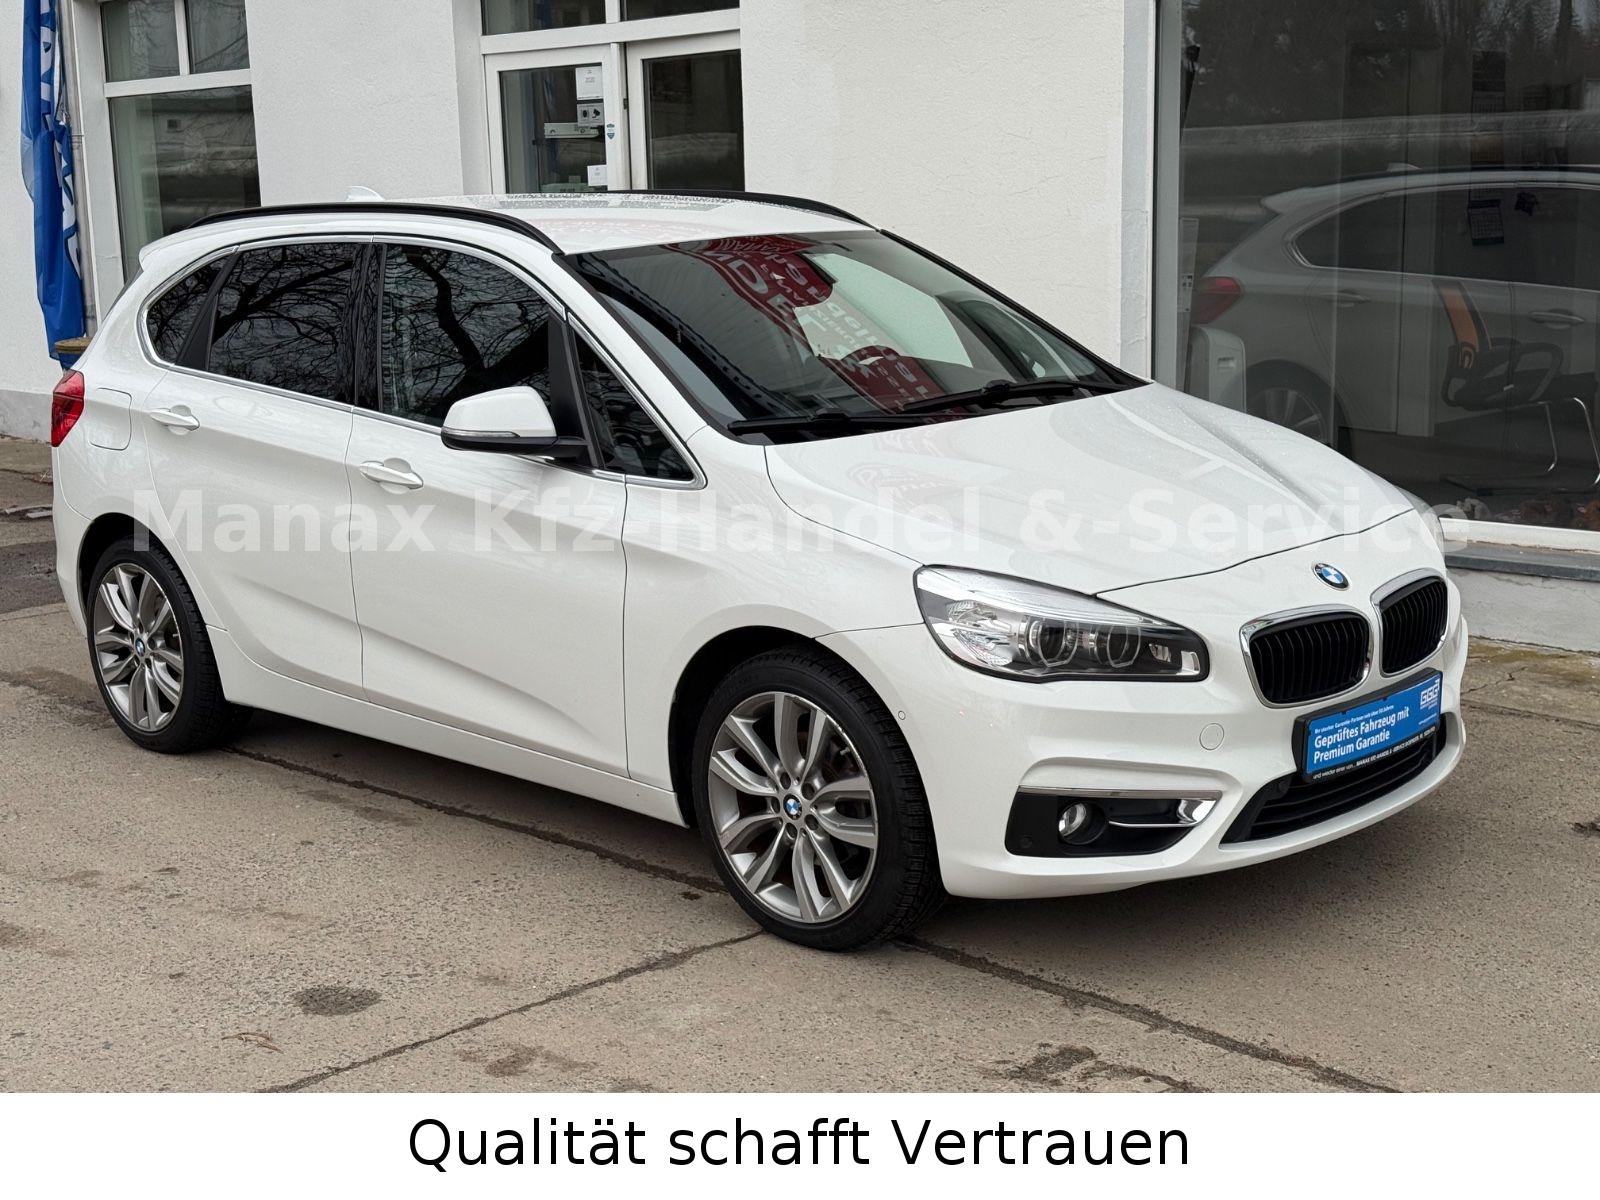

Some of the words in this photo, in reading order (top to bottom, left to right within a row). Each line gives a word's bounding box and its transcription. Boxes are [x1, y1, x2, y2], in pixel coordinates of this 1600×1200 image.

[1313, 743, 1355, 764] Premium
[1356, 729, 1390, 751] Garantie
[1314, 727, 1359, 749] Geprüftes
[1360, 715, 1396, 734] Fahrzeug
[1397, 706, 1410, 721] mit
